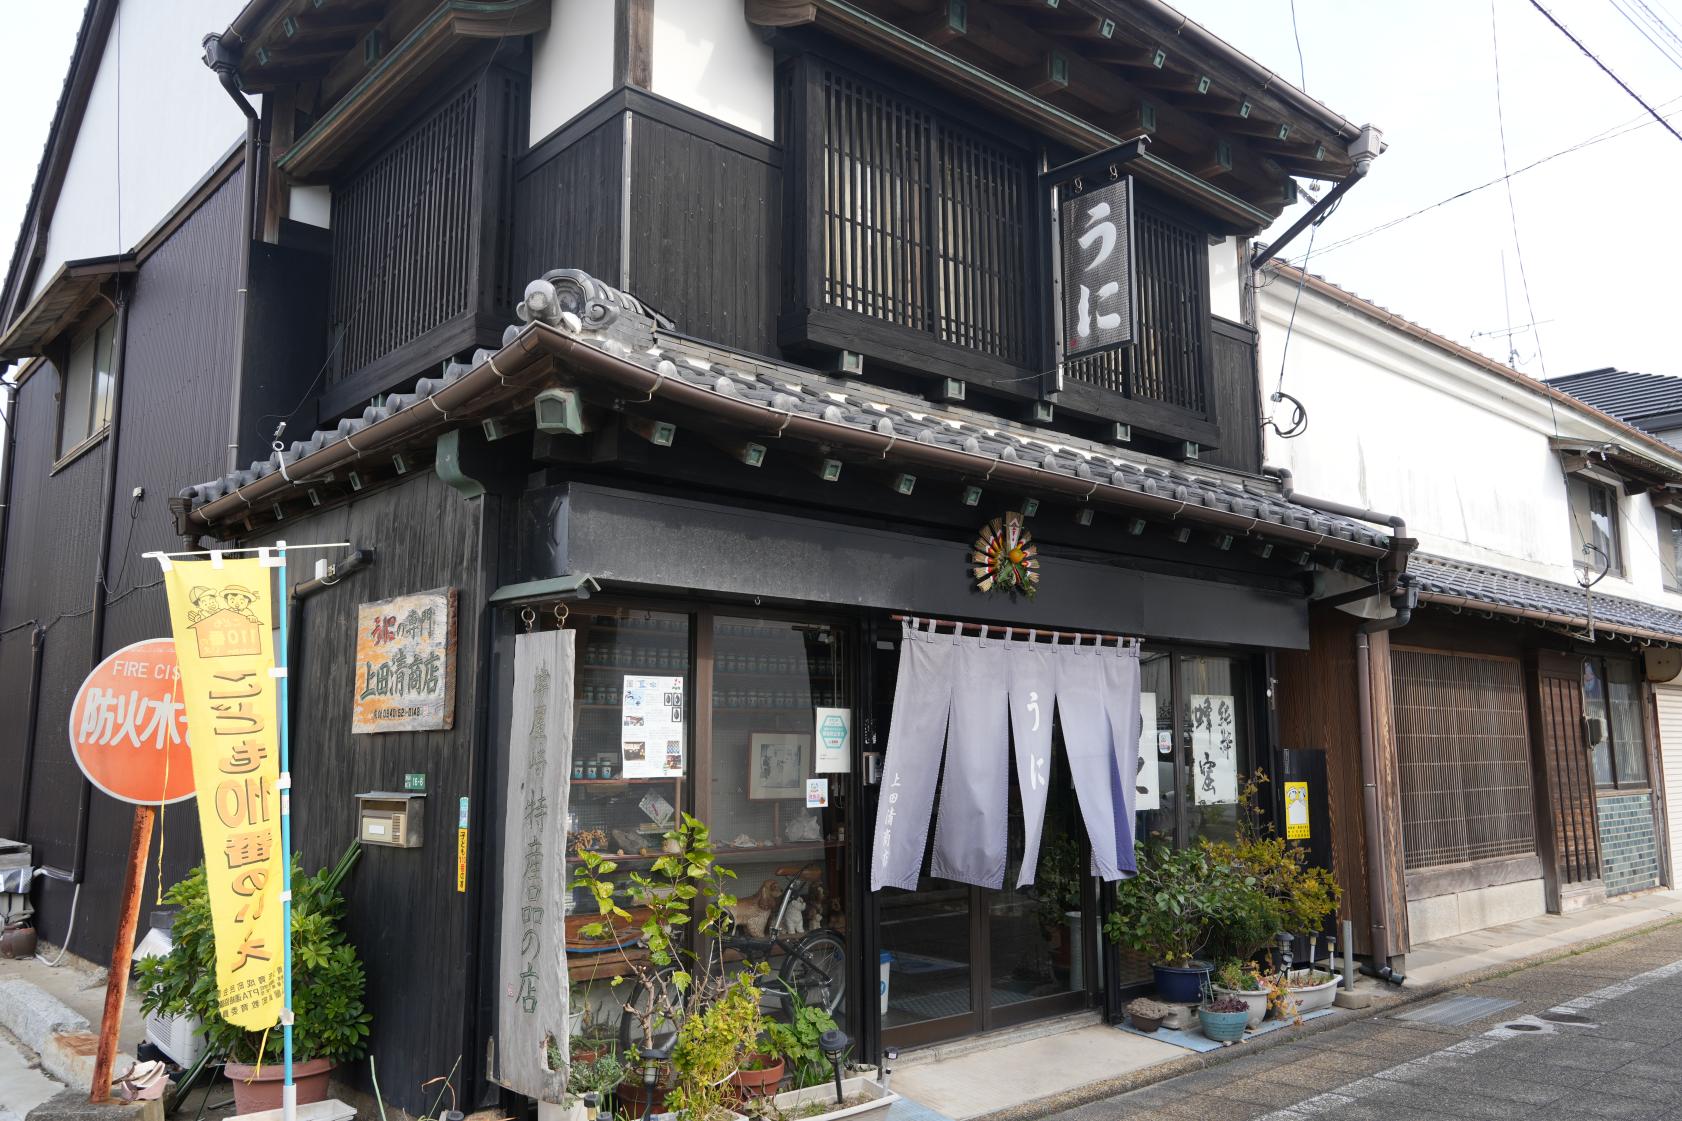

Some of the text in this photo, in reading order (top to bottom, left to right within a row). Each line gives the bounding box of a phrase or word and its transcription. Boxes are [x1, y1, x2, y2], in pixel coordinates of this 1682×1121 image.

[1077, 202, 1121, 337] うに
[112, 661, 150, 678] FIRE
[360, 648, 440, 701] 上田清商店
[1027, 691, 1046, 790] うに
